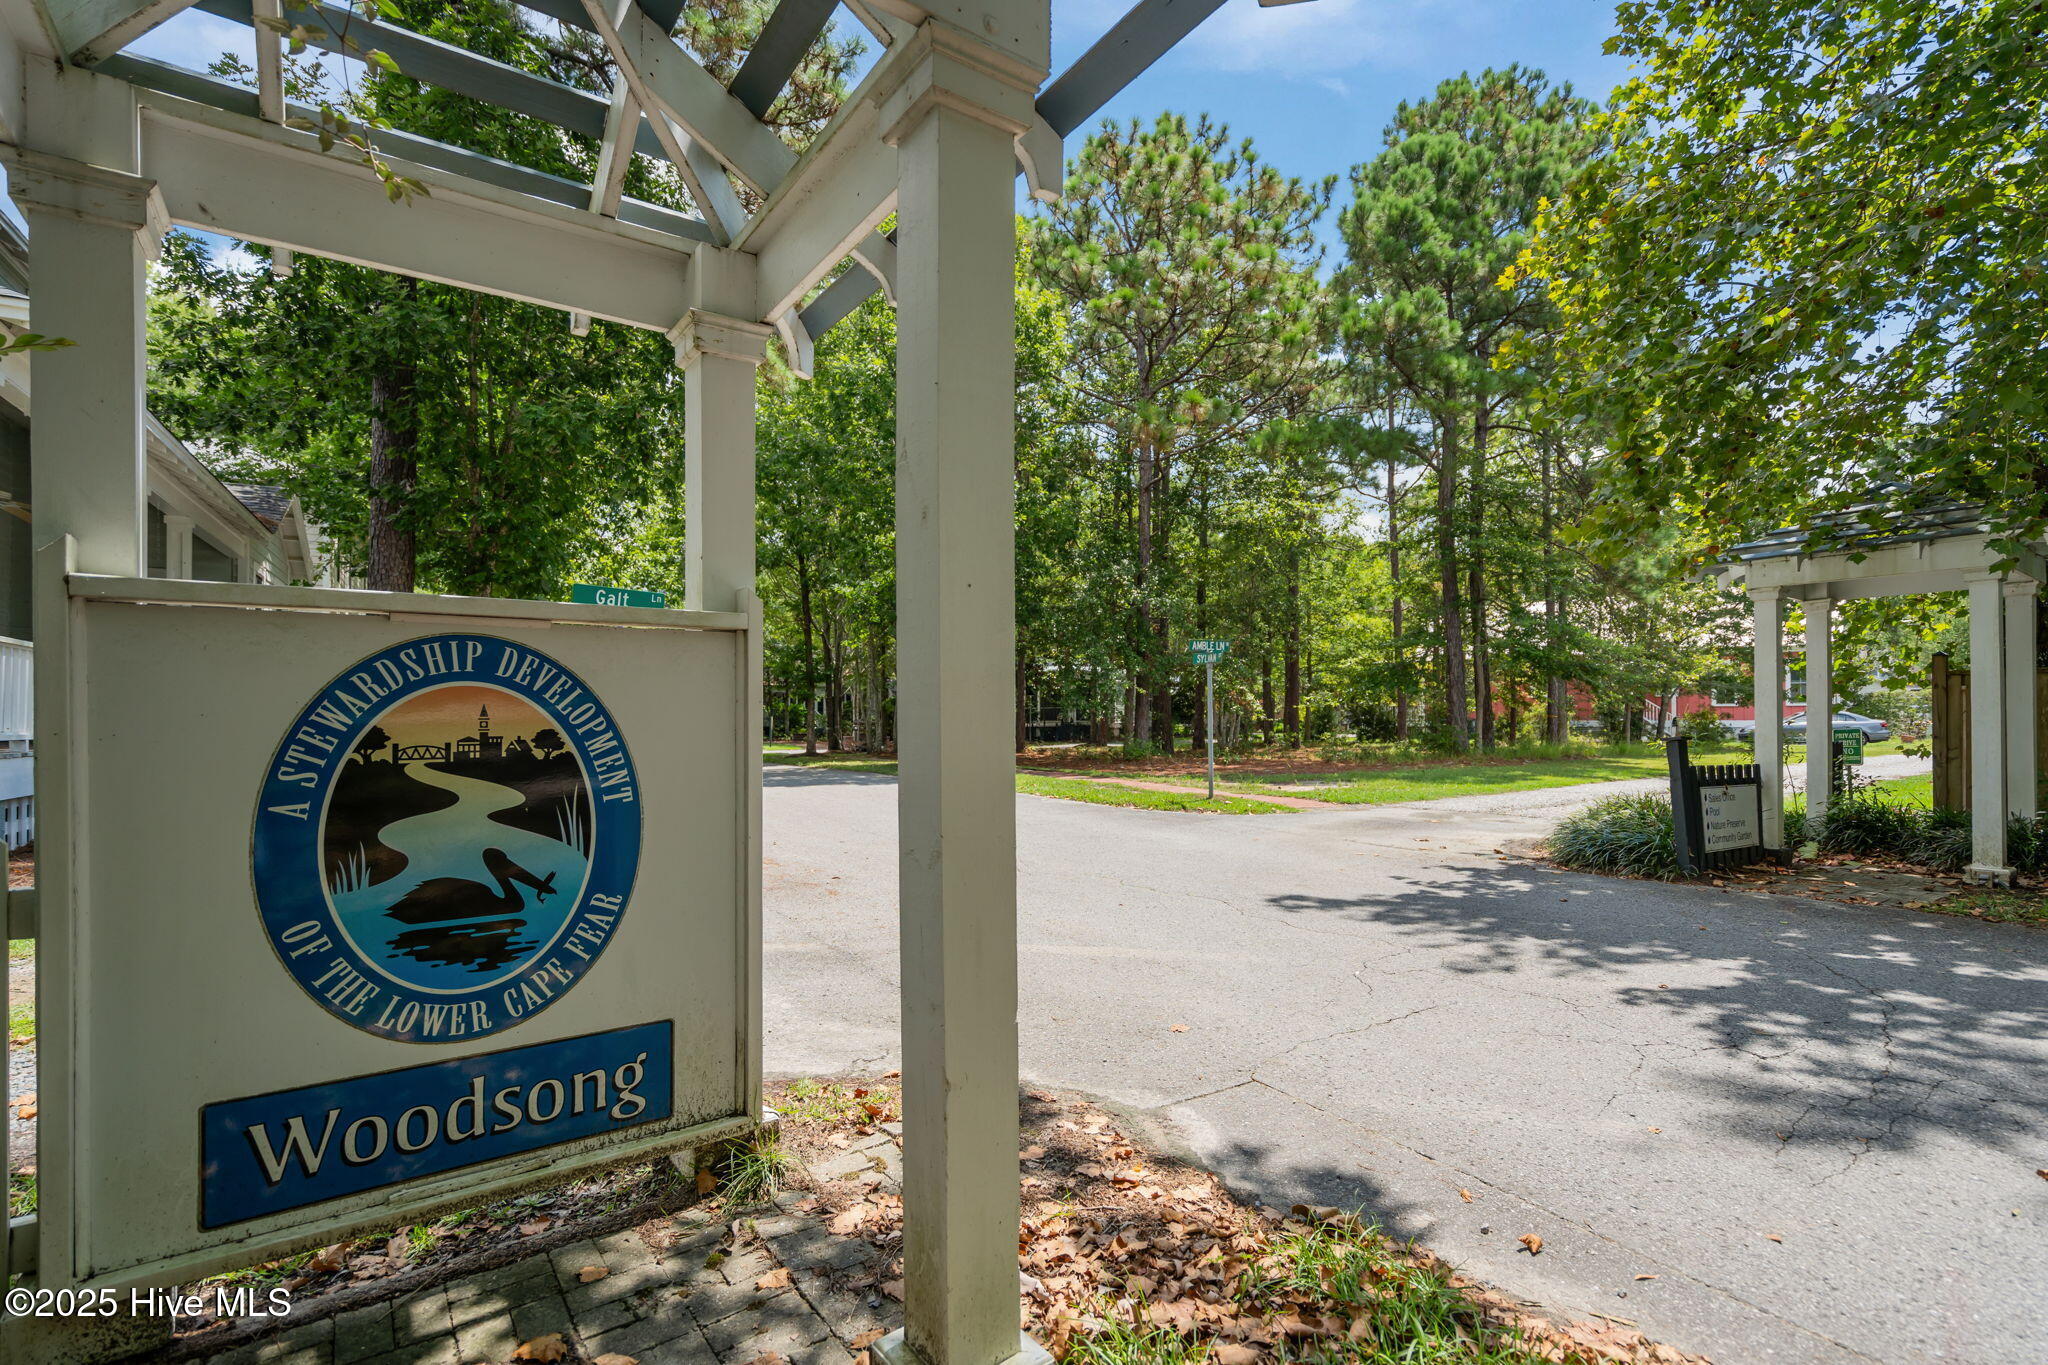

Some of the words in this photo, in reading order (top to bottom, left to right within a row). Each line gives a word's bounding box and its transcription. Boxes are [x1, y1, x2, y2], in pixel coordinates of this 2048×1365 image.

[596, 589, 629, 606] Galt
[651, 594, 662, 603] Ln
[1192, 641, 1214, 651] AMBLE
[1216, 641, 1225, 651] LN
[277, 640, 483, 790] STEWARDSHIP
[495, 646, 633, 804] DEVELOPMENT
[267, 801, 310, 820] A
[1709, 807, 1720, 816] Pool
[1711, 821, 1726, 830] Nature
[1727, 819, 1746, 828] Preserve
[1711, 833, 1736, 845] Community
[1736, 831, 1753, 841] Garden
[281, 919, 334, 960] OF
[311, 957, 381, 1017] THE
[375, 995, 492, 1036] LOWER
[503, 957, 574, 1018] CAPE
[562, 893, 623, 968] FEAR
[245, 1051, 647, 1185] Woodsong
